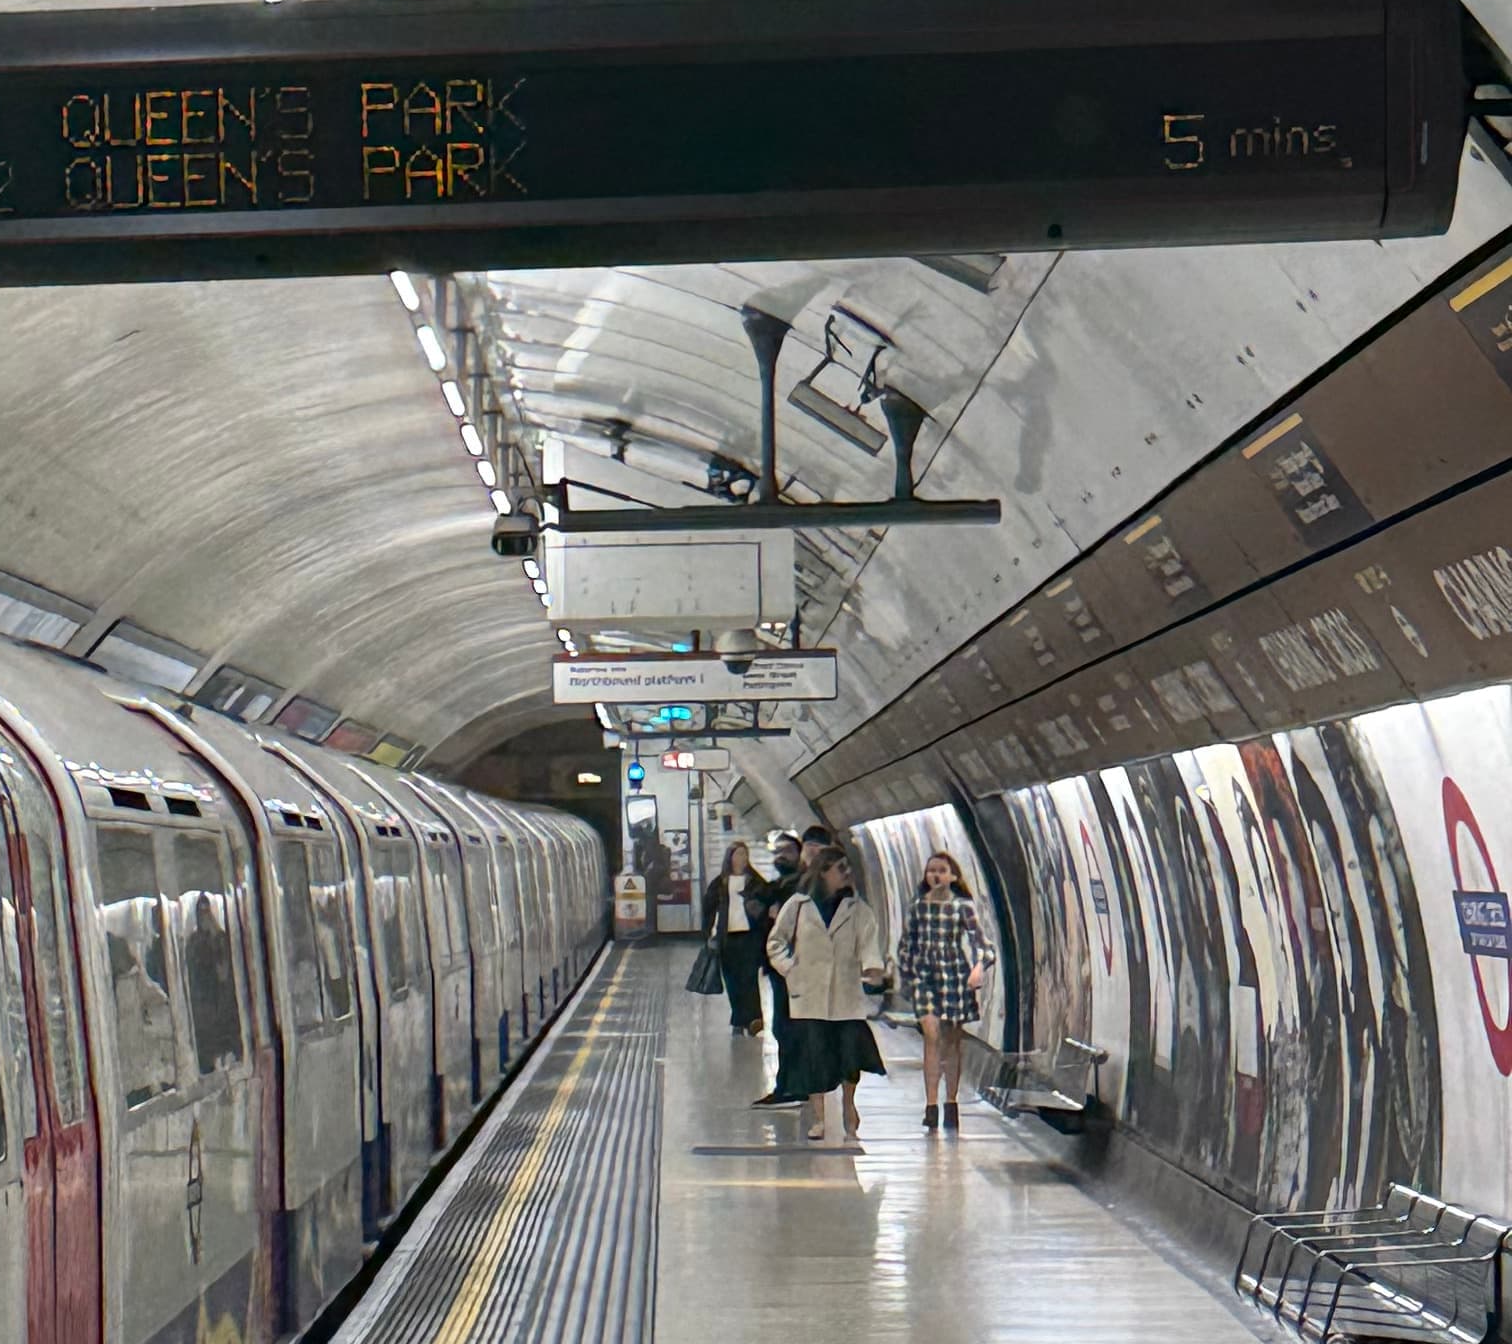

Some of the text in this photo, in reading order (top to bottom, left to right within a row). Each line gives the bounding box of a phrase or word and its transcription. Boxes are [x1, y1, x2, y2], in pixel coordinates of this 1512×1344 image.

[61, 85, 315, 150] QUEEN'S
[360, 78, 528, 136] PARK
[64, 148, 317, 211] QUEEN'S
[361, 137, 529, 200] PARK
[1162, 113, 1206, 171] 5
